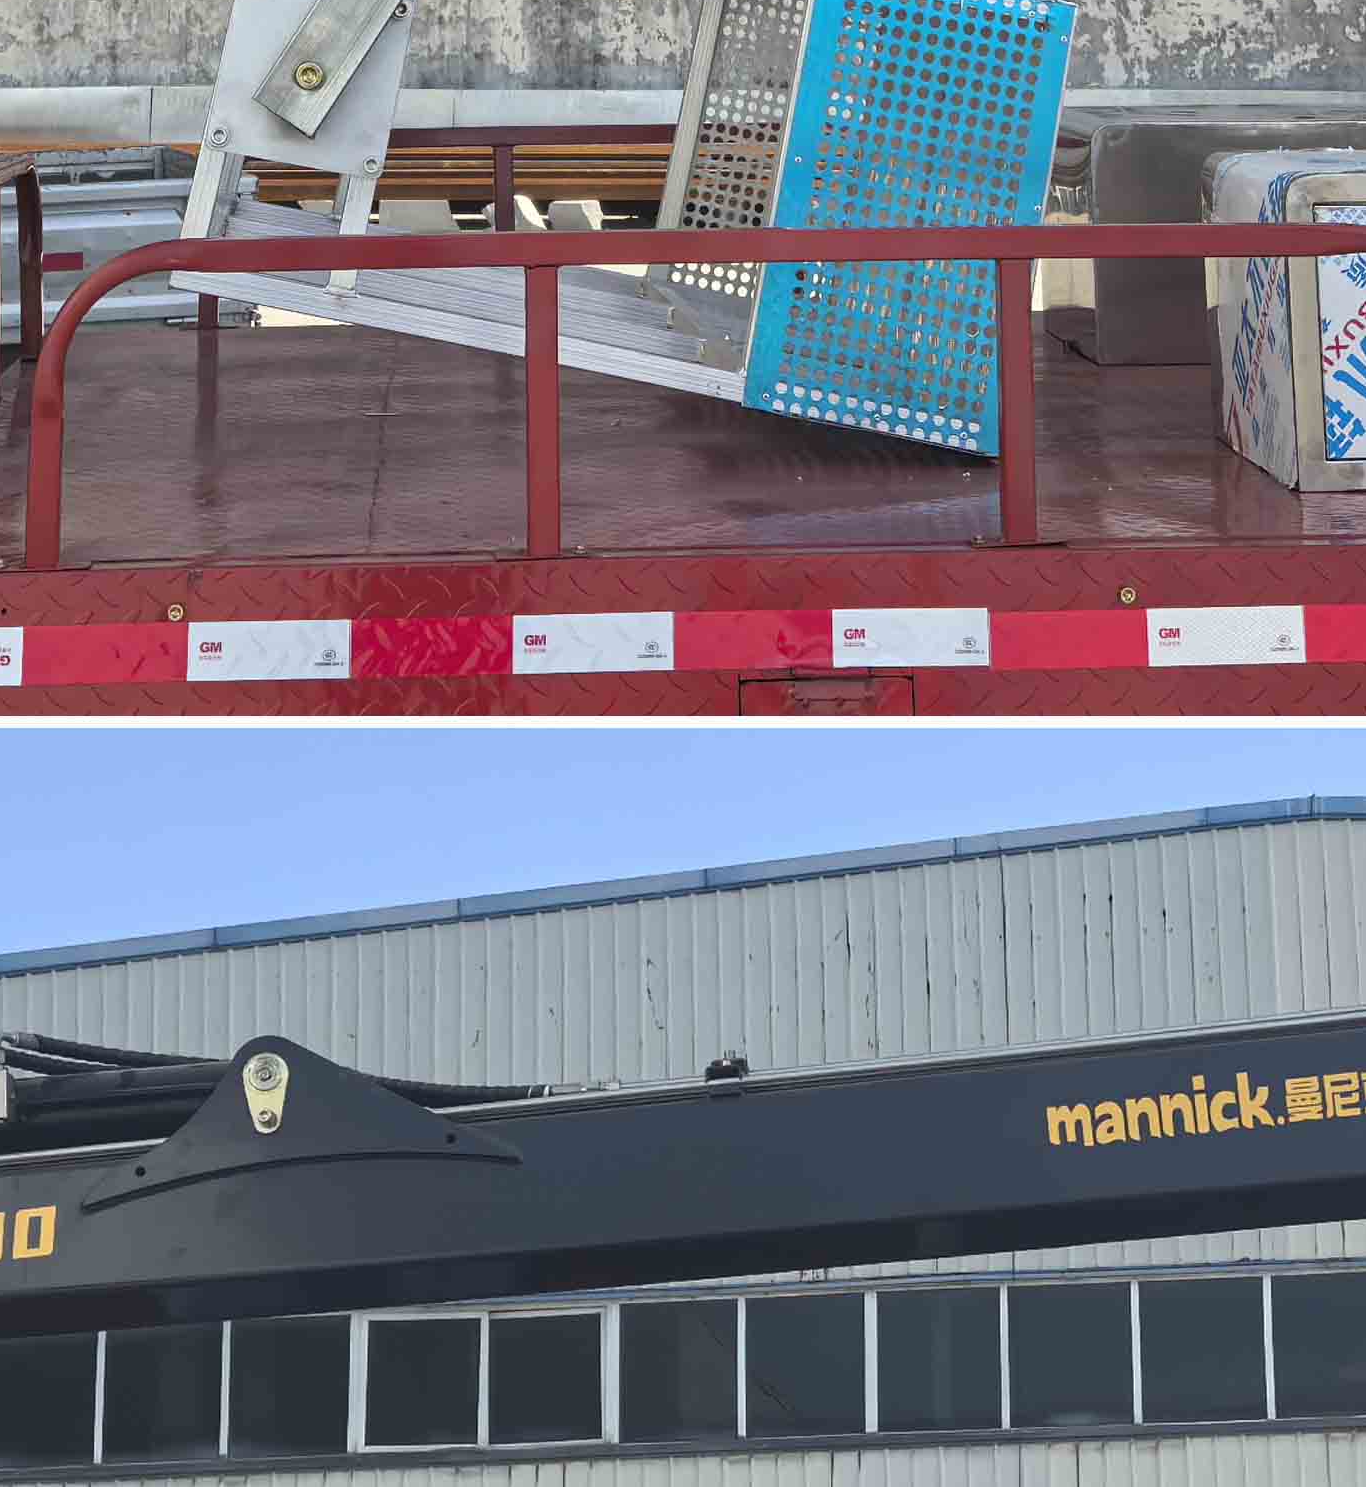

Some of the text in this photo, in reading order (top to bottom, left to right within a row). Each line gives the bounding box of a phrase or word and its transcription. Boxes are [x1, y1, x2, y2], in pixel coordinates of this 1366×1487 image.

[844, 629, 865, 640] GM
[1159, 628, 1180, 639] GM
[524, 634, 546, 646] GM
[200, 642, 222, 652] GM
